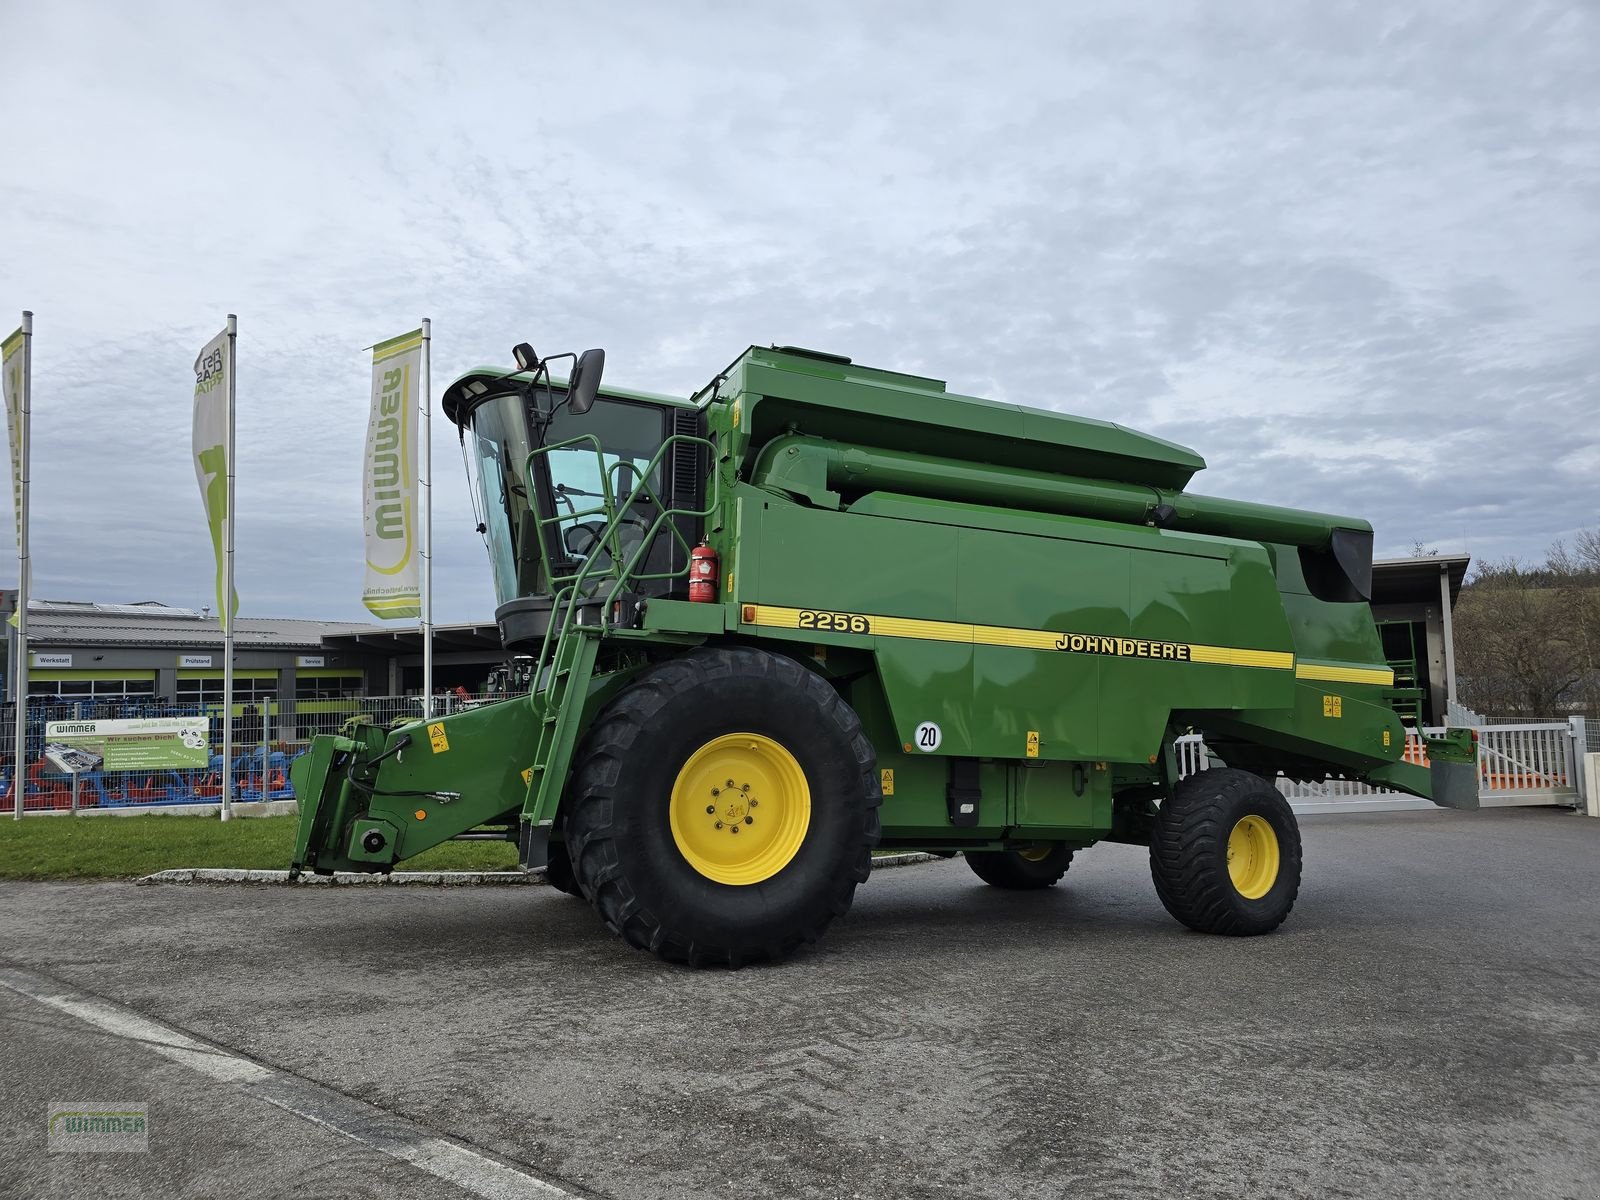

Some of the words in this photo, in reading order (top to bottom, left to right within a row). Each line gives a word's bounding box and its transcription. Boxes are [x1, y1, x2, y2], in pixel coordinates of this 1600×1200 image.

[799, 611, 870, 634] 2256
[1056, 634, 1118, 655] JOHN
[1120, 640, 1191, 661] DEERE
[56, 724, 96, 733] WIMMER
[920, 727, 937, 747] 20
